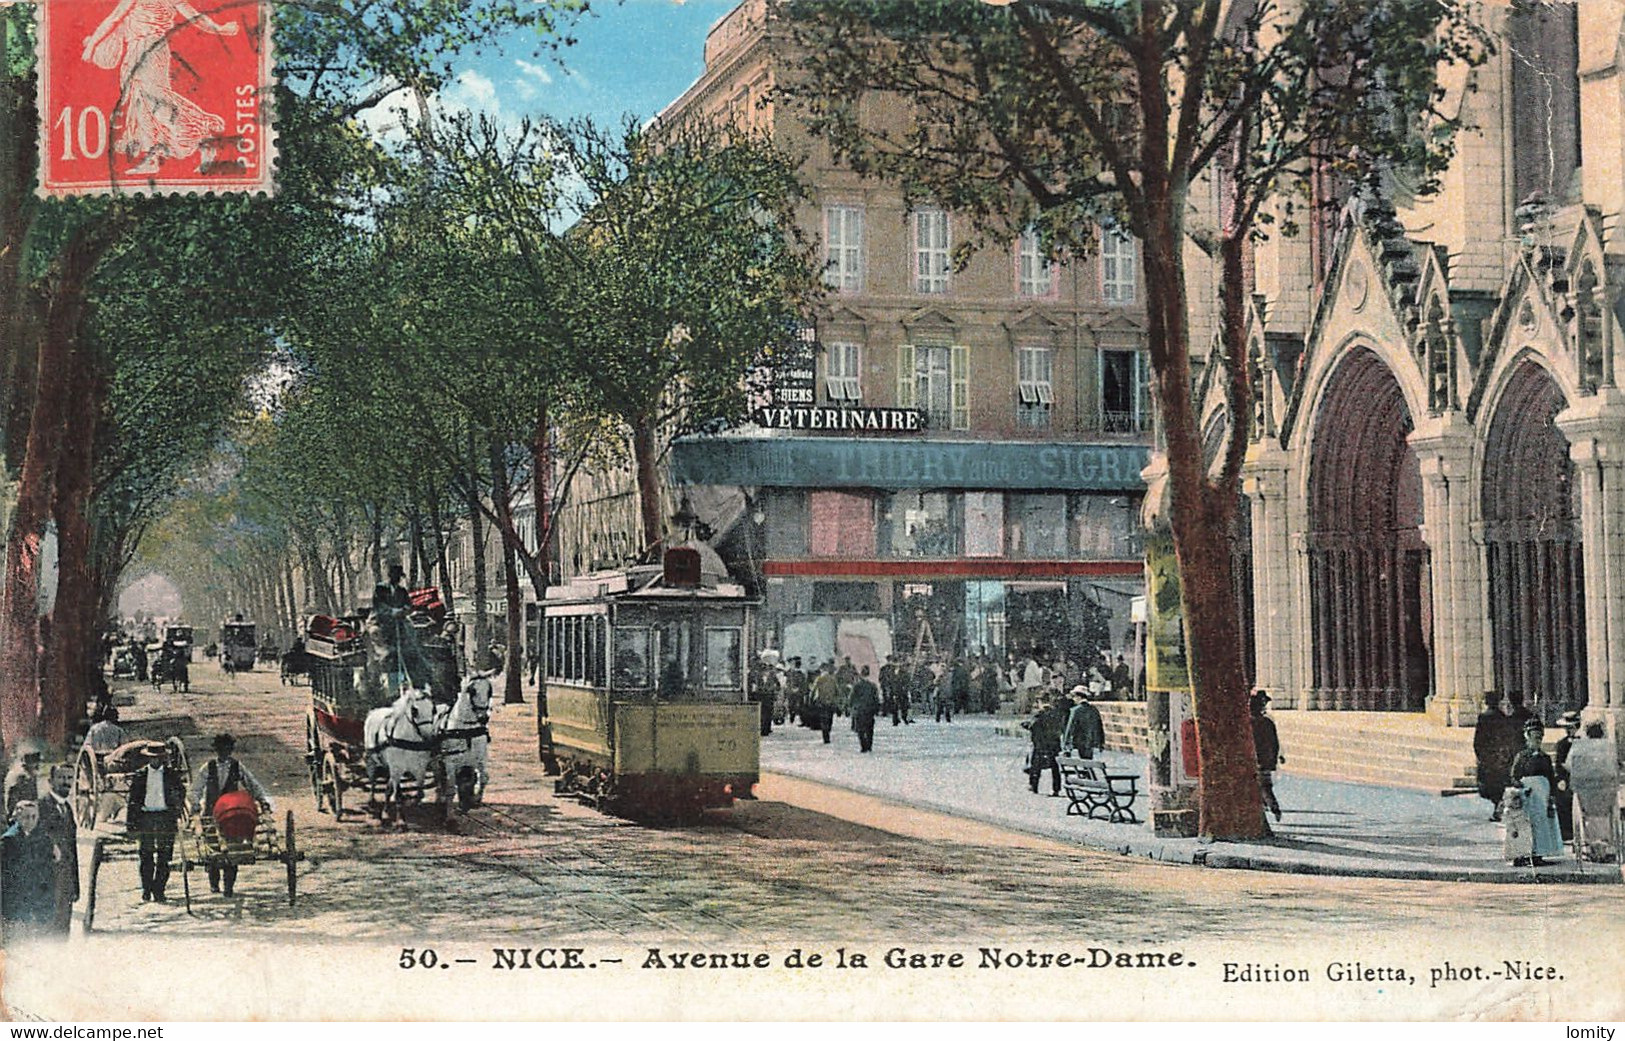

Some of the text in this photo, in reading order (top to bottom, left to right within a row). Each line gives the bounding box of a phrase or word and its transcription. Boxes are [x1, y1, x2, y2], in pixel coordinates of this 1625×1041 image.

[236, 84, 255, 169] POSTES
[762, 405, 920, 430] VÉTÉRINAIRE
[832, 449, 967, 481] THIERY
